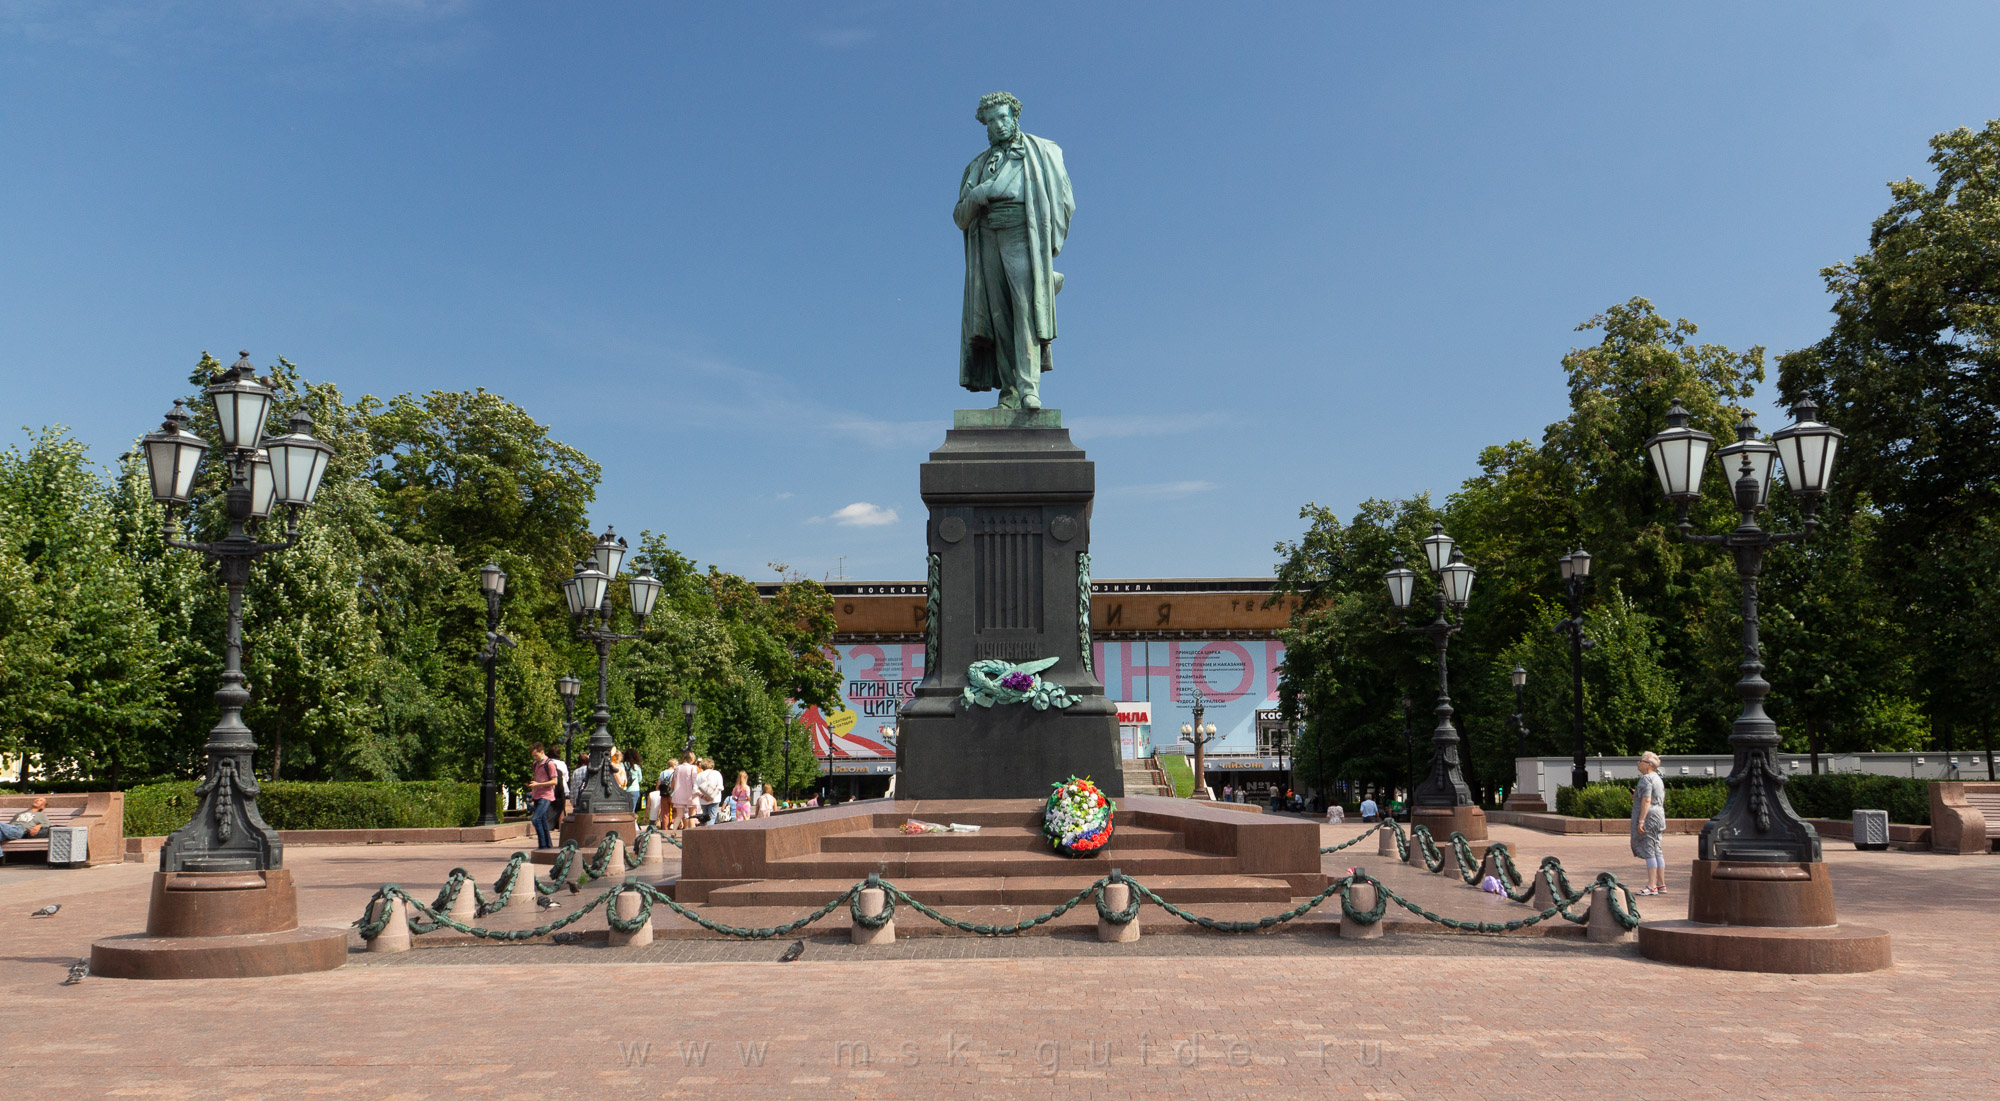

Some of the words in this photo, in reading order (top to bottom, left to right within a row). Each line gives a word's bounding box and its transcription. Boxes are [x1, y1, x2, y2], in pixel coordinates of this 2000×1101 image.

[849, 681, 919, 698] ПРИНЦЕСС
[863, 699, 902, 717] ЦИРК
[1114, 711, 1149, 723] ИКЛА
